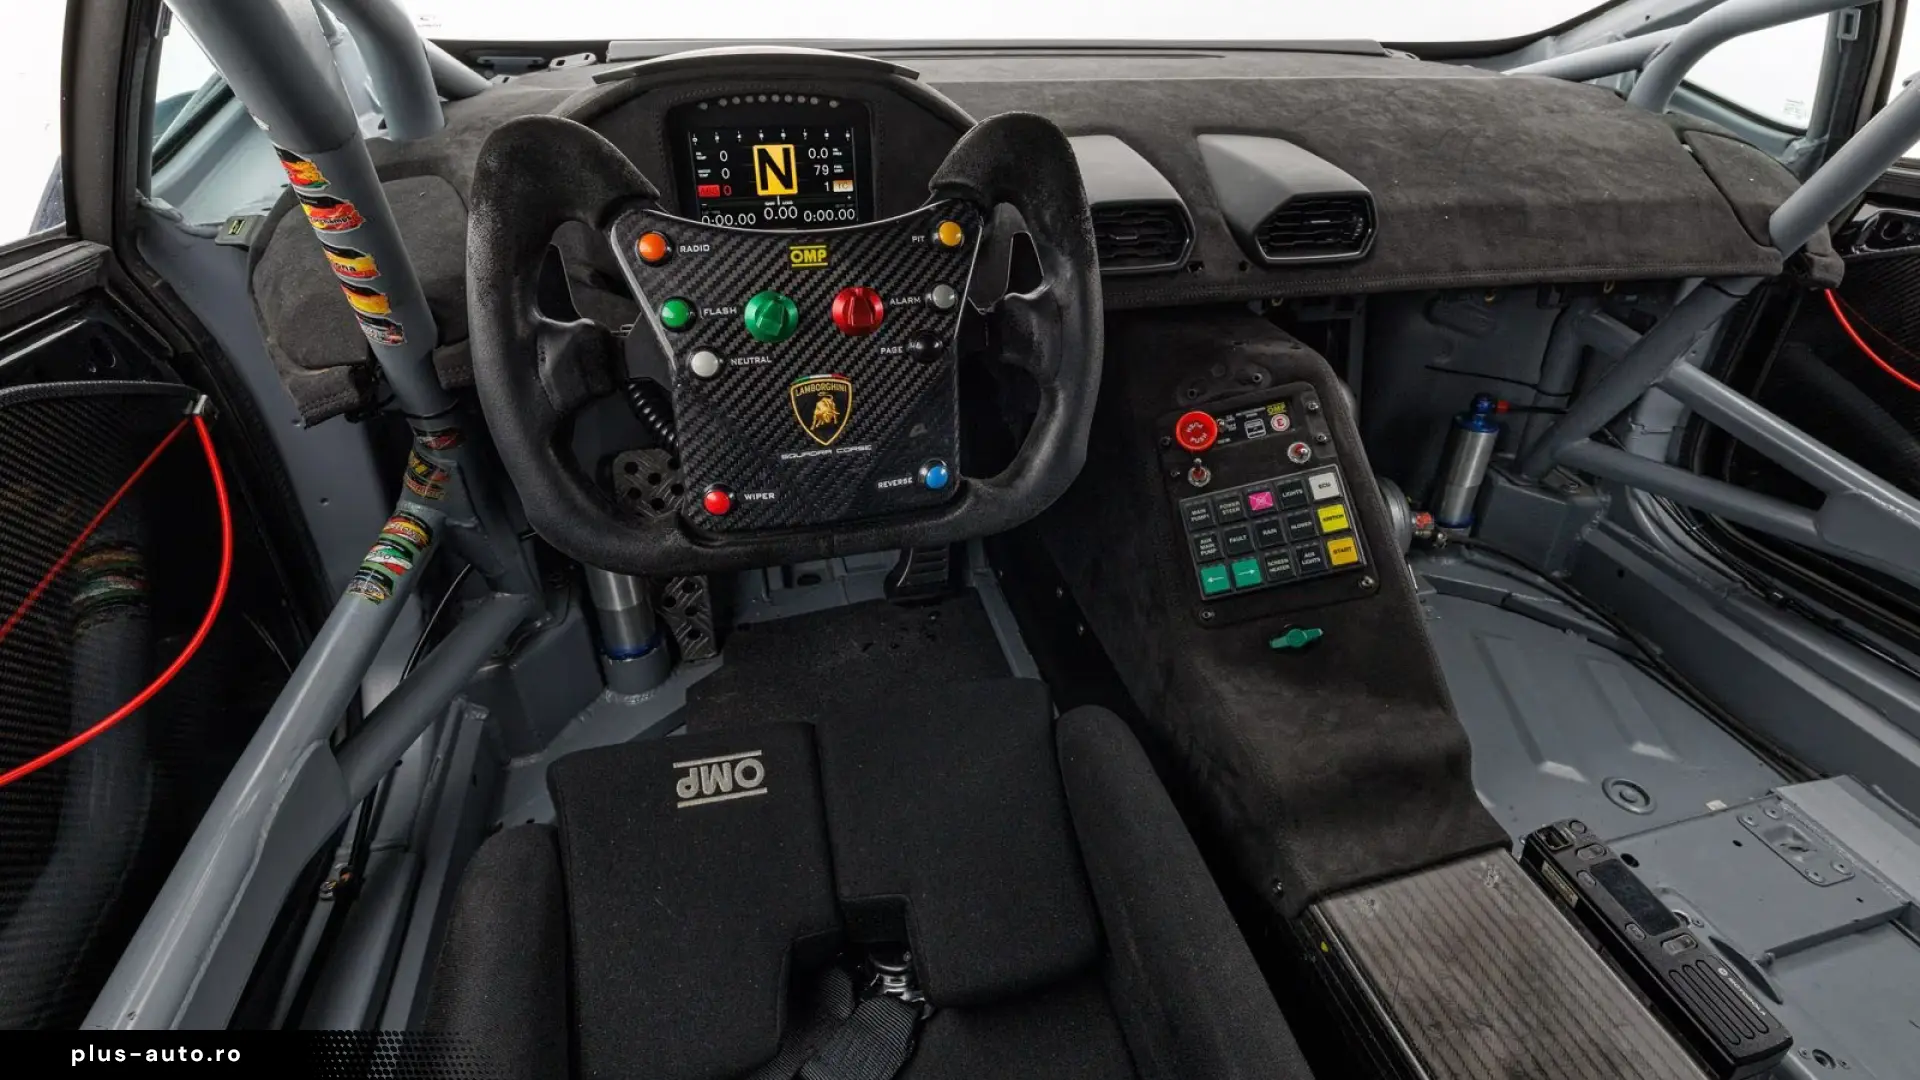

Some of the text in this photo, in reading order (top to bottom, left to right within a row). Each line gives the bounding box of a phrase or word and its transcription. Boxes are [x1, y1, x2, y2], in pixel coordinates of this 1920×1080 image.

[719, 150, 728, 162] 0
[808, 148, 828, 159] 0.0
[721, 168, 730, 179] 0
[757, 147, 793, 191] N
[813, 165, 829, 176] 79
[824, 182, 830, 192] 1
[763, 206, 798, 220] 0.00
[803, 208, 855, 222] 0:00.00
[912, 235, 925, 243] PIT
[679, 244, 710, 253] RADIO
[790, 249, 828, 264] OMP
[889, 296, 921, 305] ALARM
[703, 306, 737, 316] FLASH
[880, 346, 903, 354] PAGE
[730, 355, 772, 366] NEUTRAL
[795, 382, 847, 397] LAMBORGHINI
[1190, 432, 1208, 444] PUSH
[780, 444, 873, 460] SQUADRA CORSE
[877, 476, 914, 489] REVERSE
[744, 491, 775, 500] WIPER
[1282, 489, 1303, 498] LIGHTS
[1263, 527, 1277, 535] RAIN
[1290, 521, 1312, 530] BLOWER
[1229, 534, 1247, 543] FAULT
[1333, 546, 1352, 555] START
[1301, 556, 1321, 565] LIGHTS
[676, 757, 765, 799] OMP
[1727, 976, 1767, 1016] MOTOROLA
